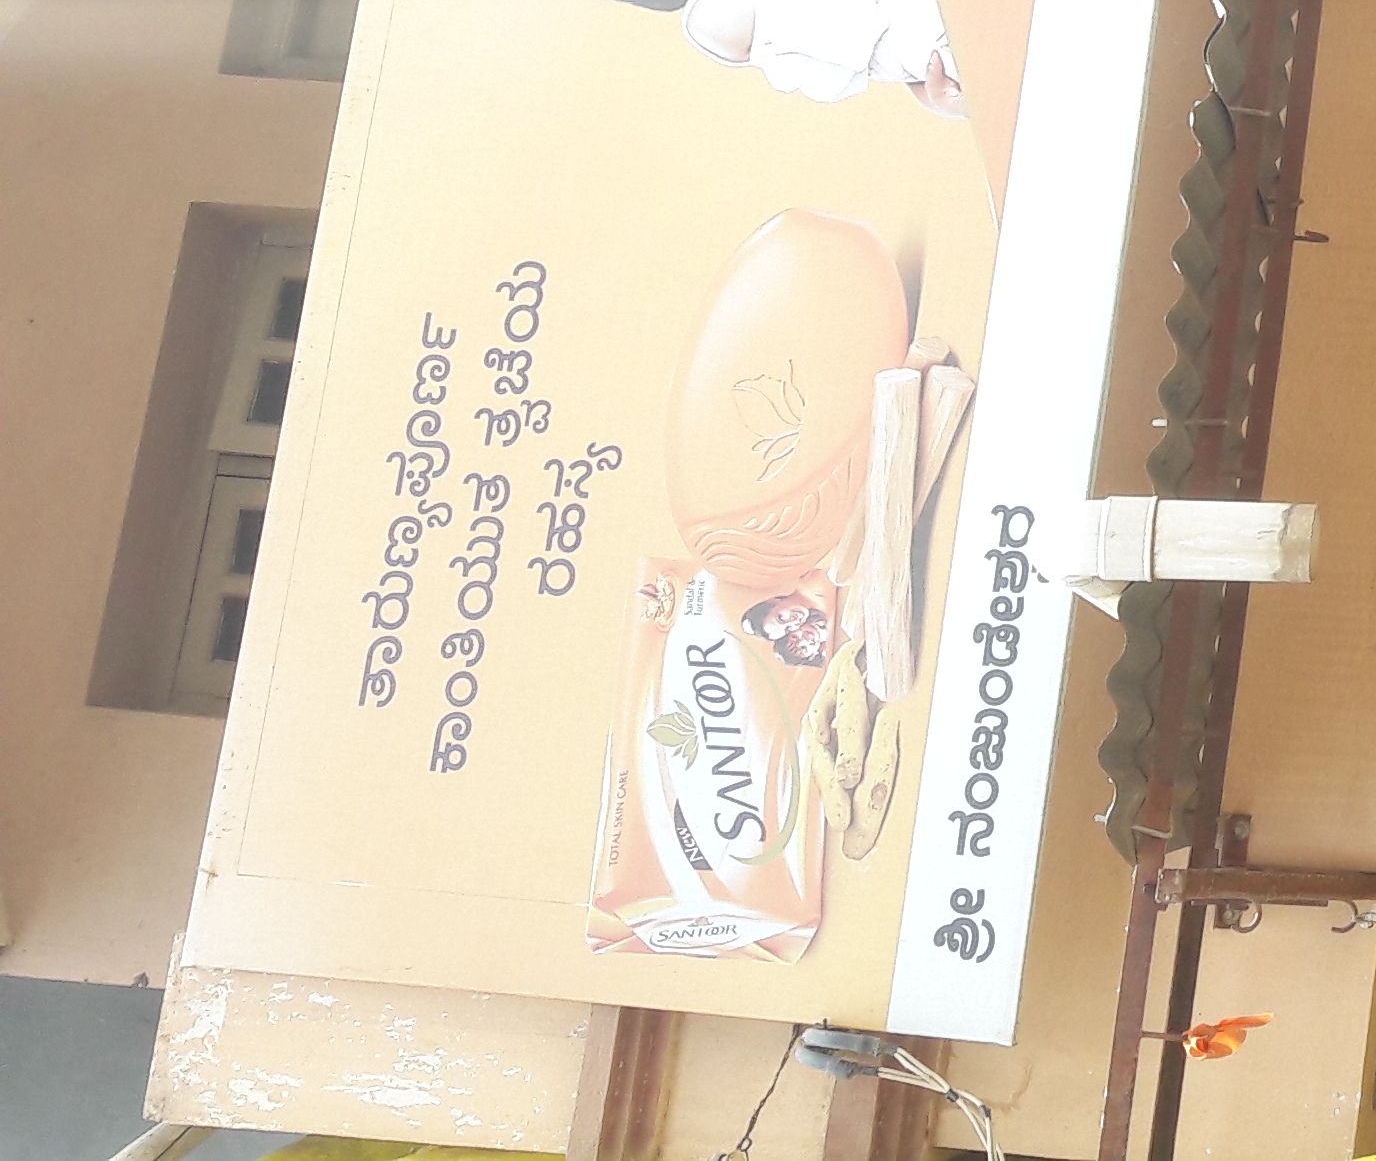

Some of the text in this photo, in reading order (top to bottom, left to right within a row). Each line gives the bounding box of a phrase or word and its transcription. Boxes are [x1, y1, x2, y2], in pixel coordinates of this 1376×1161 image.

[357, 311, 457, 708] ತಾರುಣ್ಯಪೂರ್ಣ
[429, 260, 551, 774] ಕಾಂತಿಯುತ ತ್ವಚೆಯ
[527, 441, 623, 597] ರಹಸ್ಯ
[608, 770, 628, 868] TOTAL SKIN CARE
[685, 637, 766, 843] SANTOOR
[933, 504, 1047, 964] ಶ್ರೀ ನಂಜುಂಡೇಶ್ರ
[676, 826, 704, 863] New
